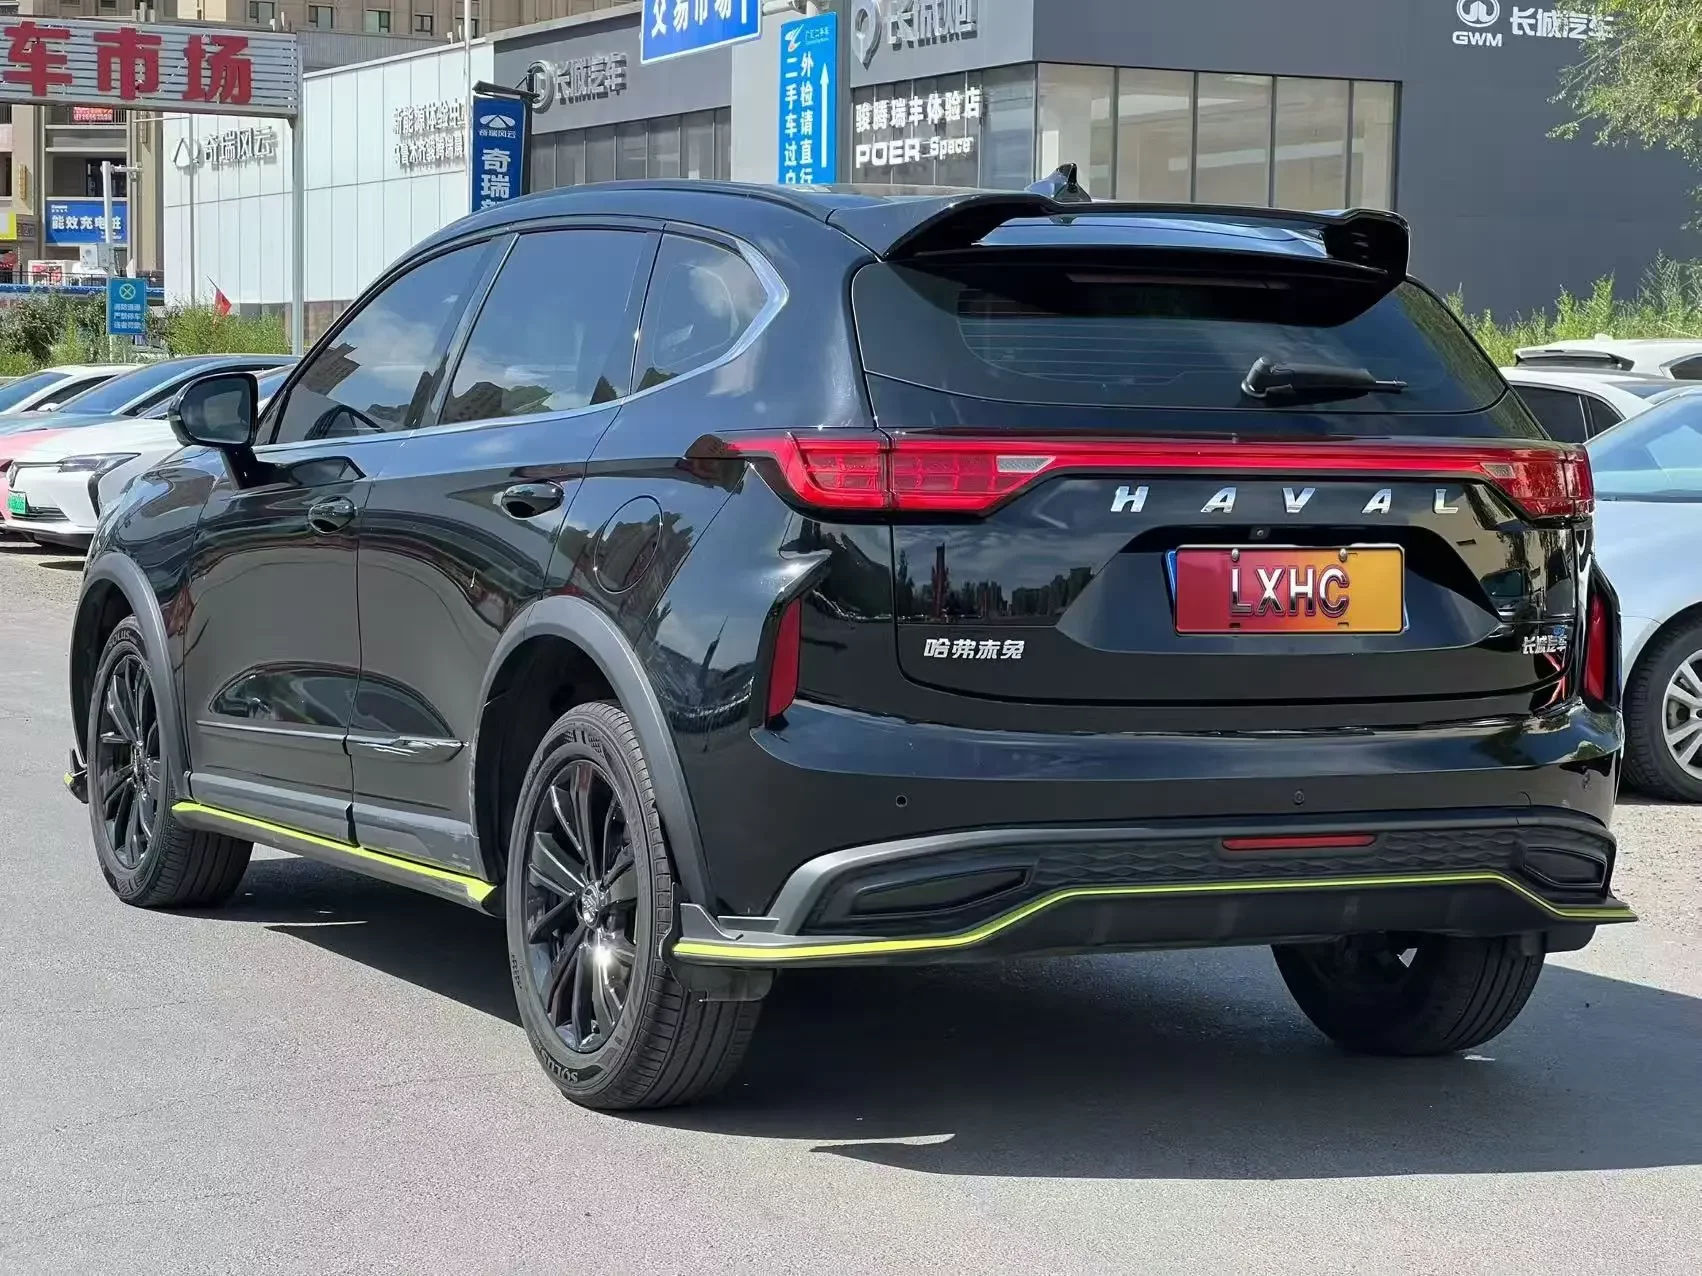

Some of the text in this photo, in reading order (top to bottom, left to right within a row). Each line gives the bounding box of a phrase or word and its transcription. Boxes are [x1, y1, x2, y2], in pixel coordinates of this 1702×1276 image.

[1452, 31, 1503, 47] GWM
[1510, 6, 1614, 41] 长城汽车
[3, 20, 253, 105] 车市场
[204, 126, 273, 162] 奇瑞风云
[856, 136, 975, 168] POER Space
[1110, 485, 1459, 514] HAVAL
[1230, 565, 1349, 617] LXHC
